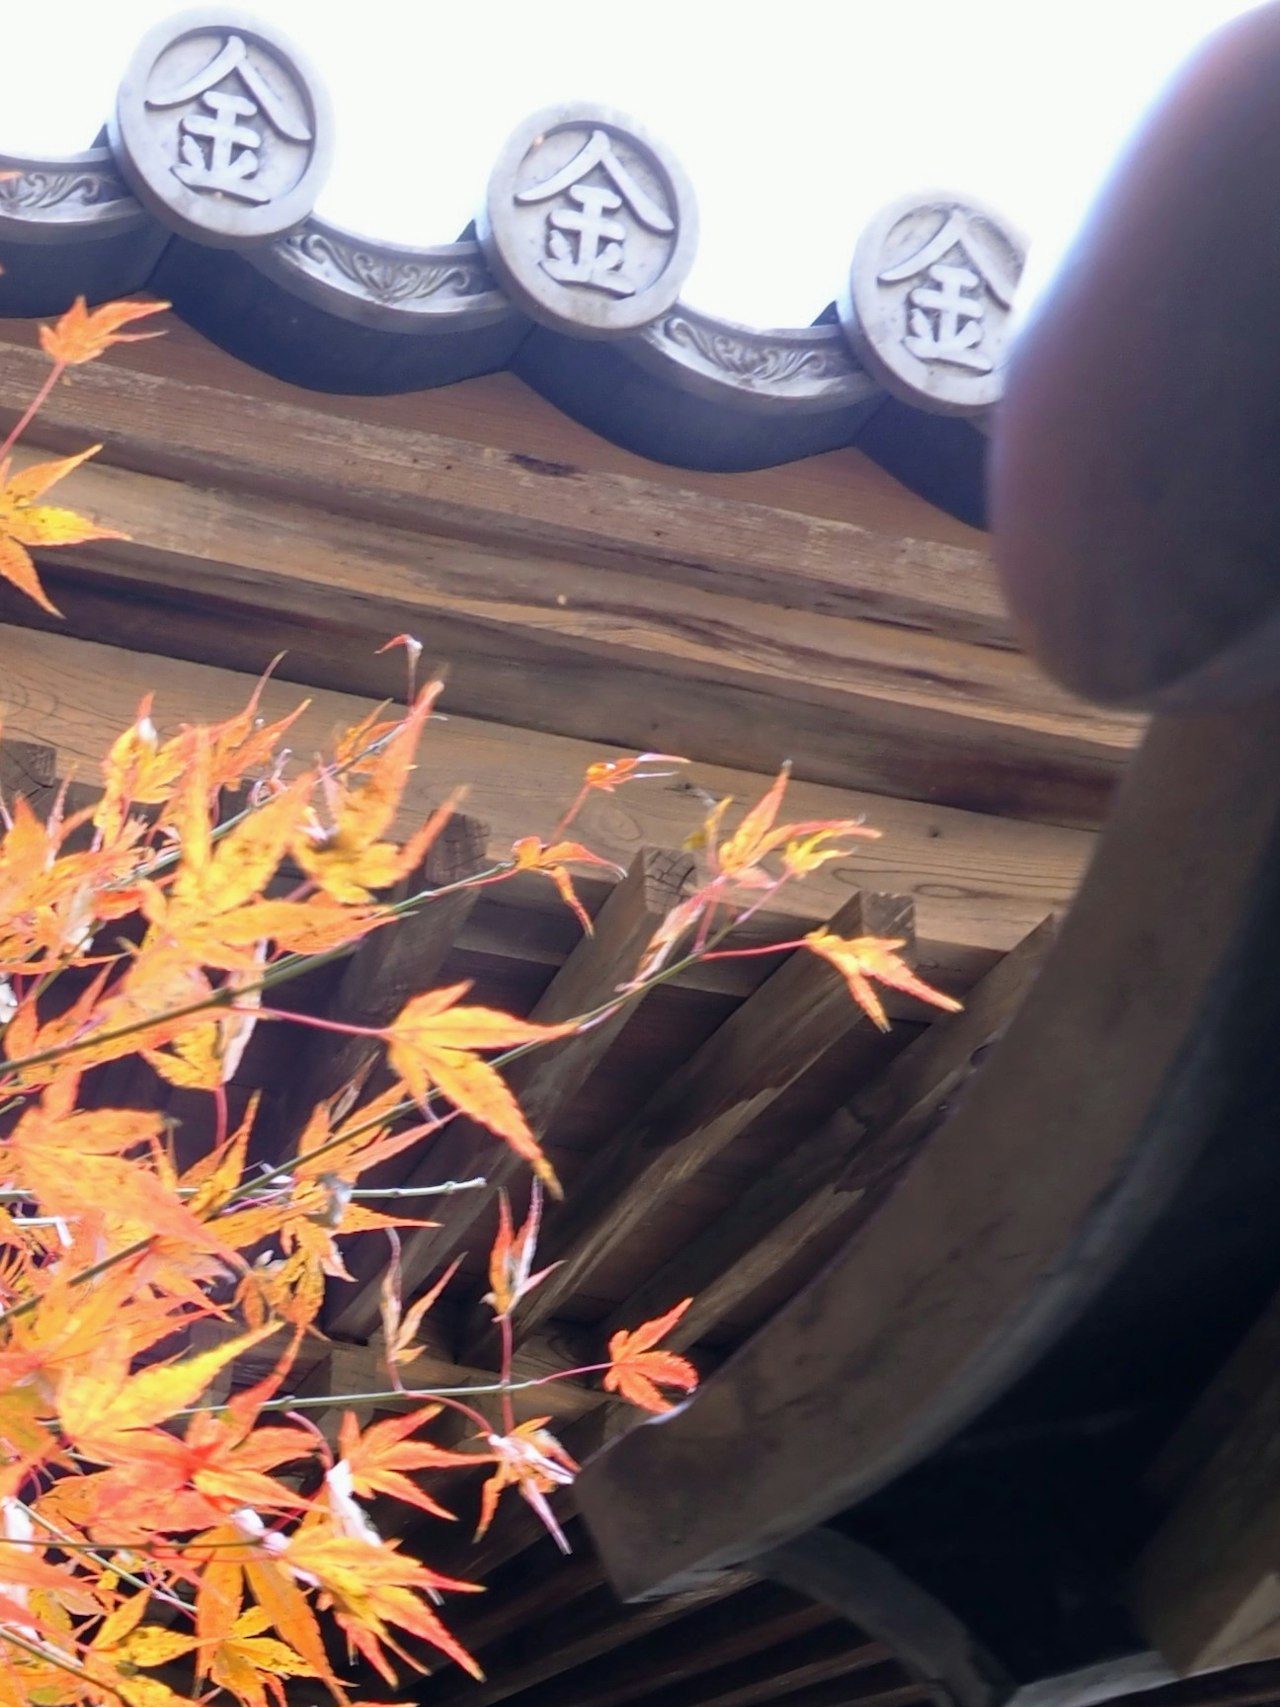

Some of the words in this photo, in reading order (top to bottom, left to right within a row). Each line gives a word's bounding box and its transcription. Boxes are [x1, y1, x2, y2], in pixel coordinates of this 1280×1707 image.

[144, 35, 313, 207] 金
[513, 129, 675, 300] 金
[877, 208, 1018, 377] 金
